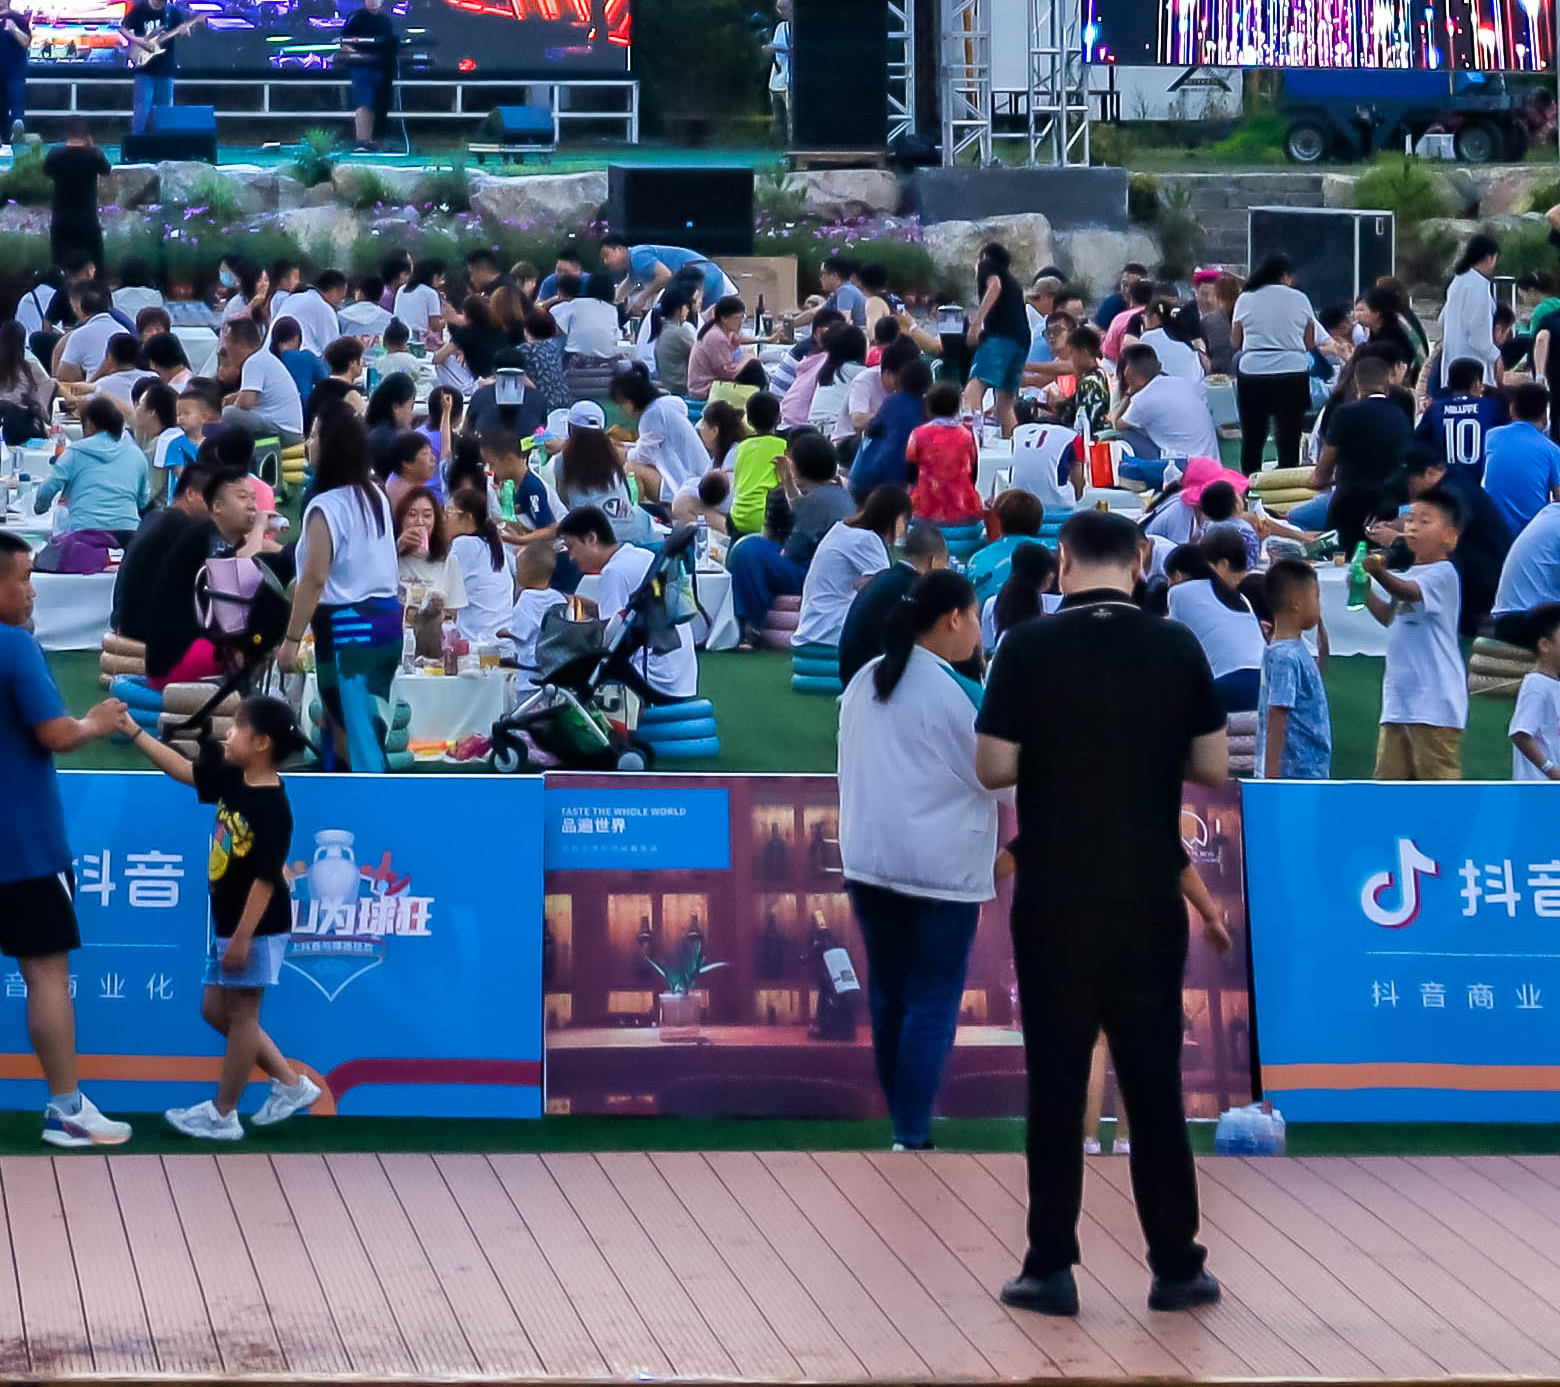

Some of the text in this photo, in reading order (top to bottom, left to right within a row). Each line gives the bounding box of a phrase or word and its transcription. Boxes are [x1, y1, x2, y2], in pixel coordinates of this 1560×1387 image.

[1443, 418, 1481, 464] 10
[593, 807, 611, 816] THE
[613, 807, 648, 816] WHOLE
[650, 807, 687, 816] WORLD
